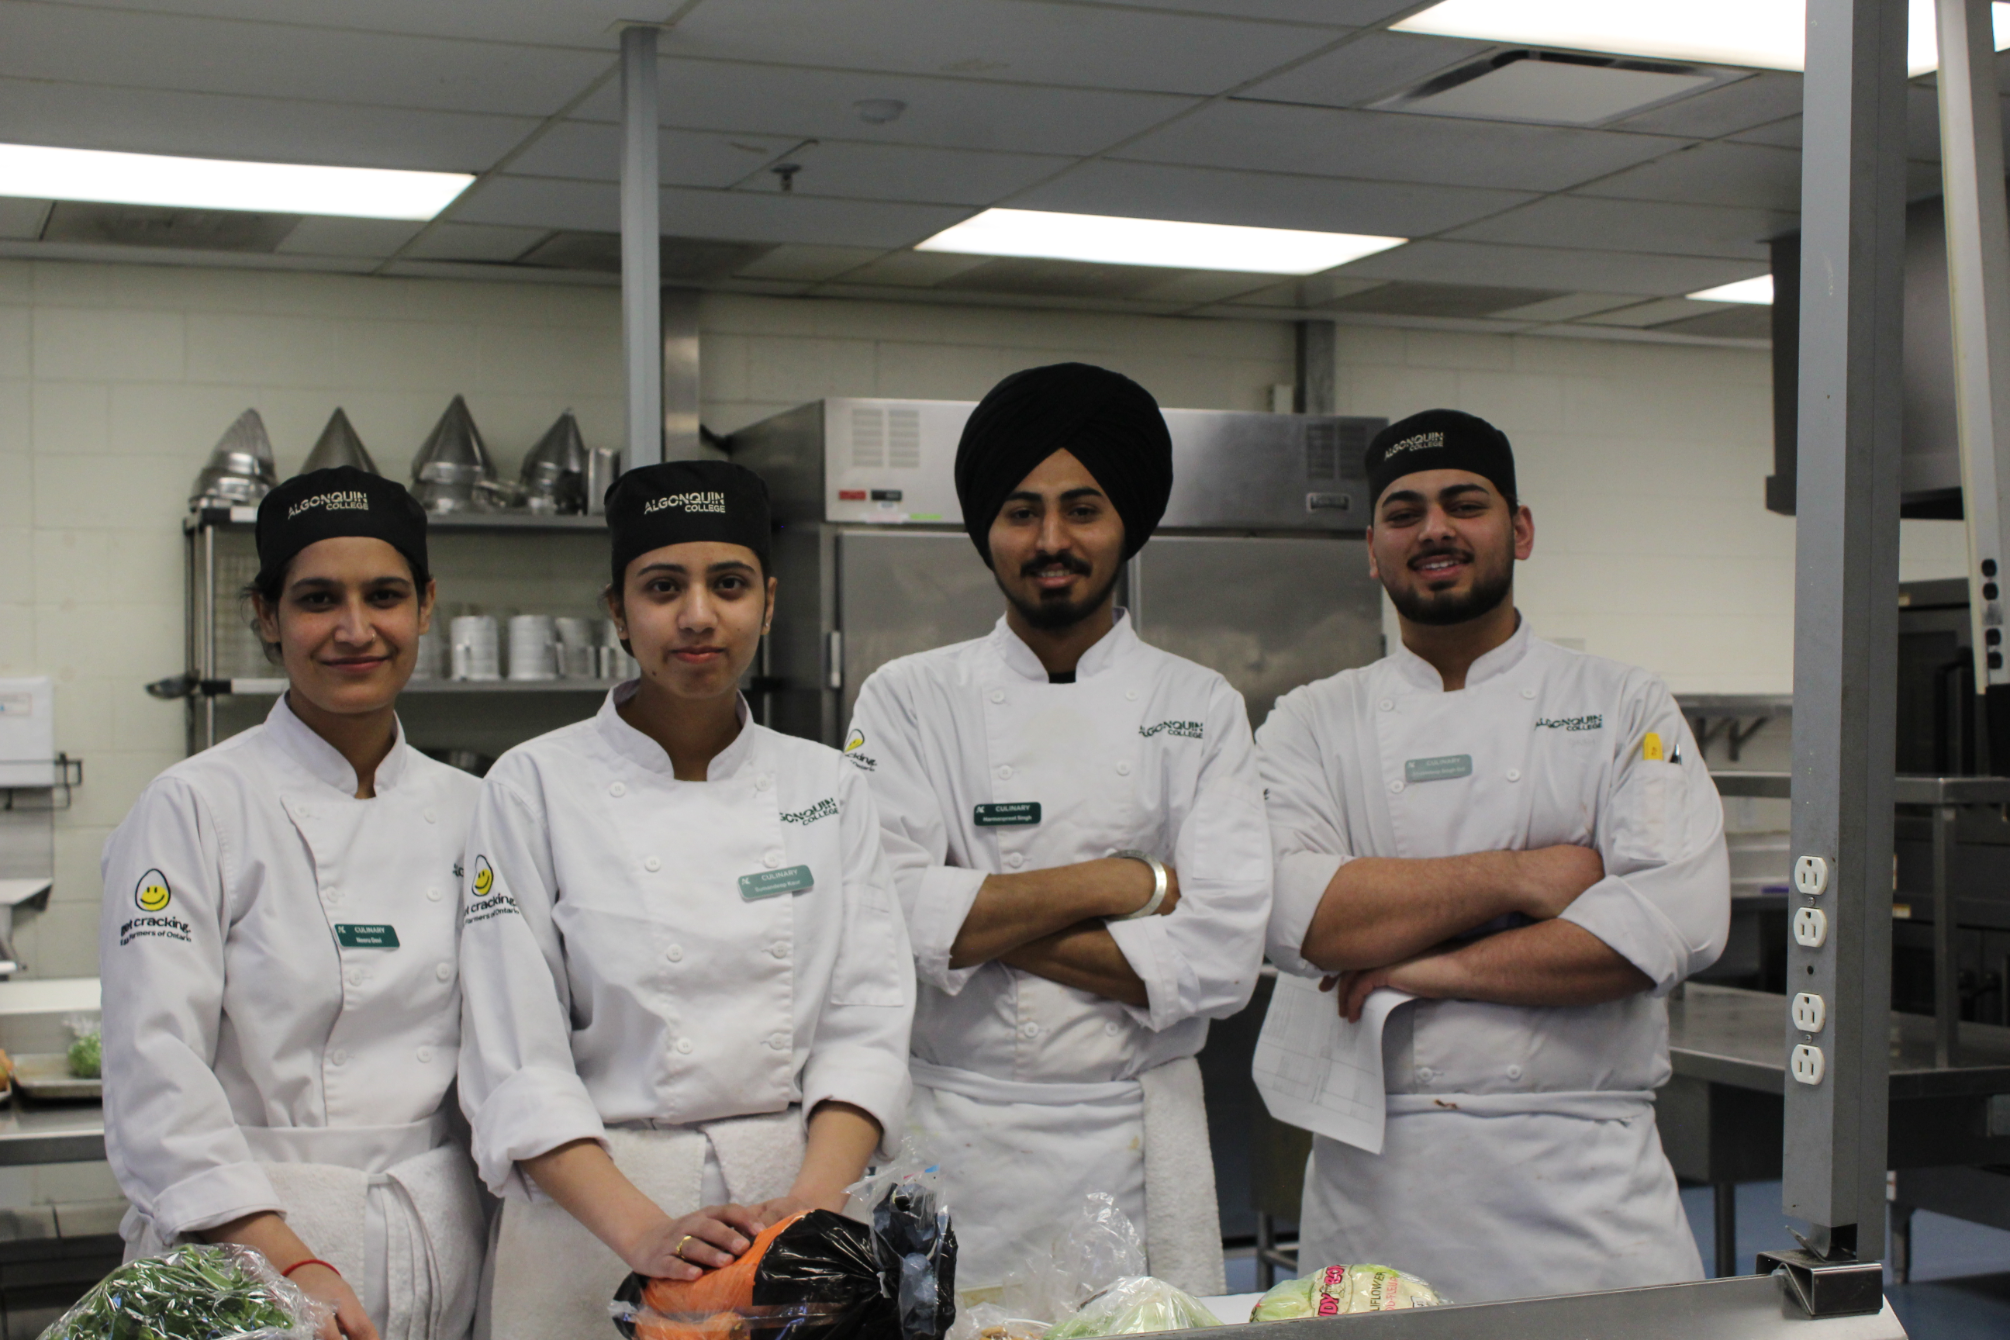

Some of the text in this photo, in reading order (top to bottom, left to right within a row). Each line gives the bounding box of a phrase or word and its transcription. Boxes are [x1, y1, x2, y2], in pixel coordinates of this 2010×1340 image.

[1384, 432, 1444, 461] ALGONQUIN
[1409, 441, 1444, 452] COLLEGE
[288, 491, 368, 520] ALGONQUIN
[326, 501, 369, 511] COLLEGE
[644, 491, 725, 515] ALGONQUIN
[684, 504, 726, 513] COLLEGE
[1167, 728, 1203, 739] COLLEGE
[995, 804, 1031, 812] CULINARY
[761, 869, 798, 880] CULINARY
[354, 926, 385, 934] CULINARY
[166, 931, 192, 942] Ontario
